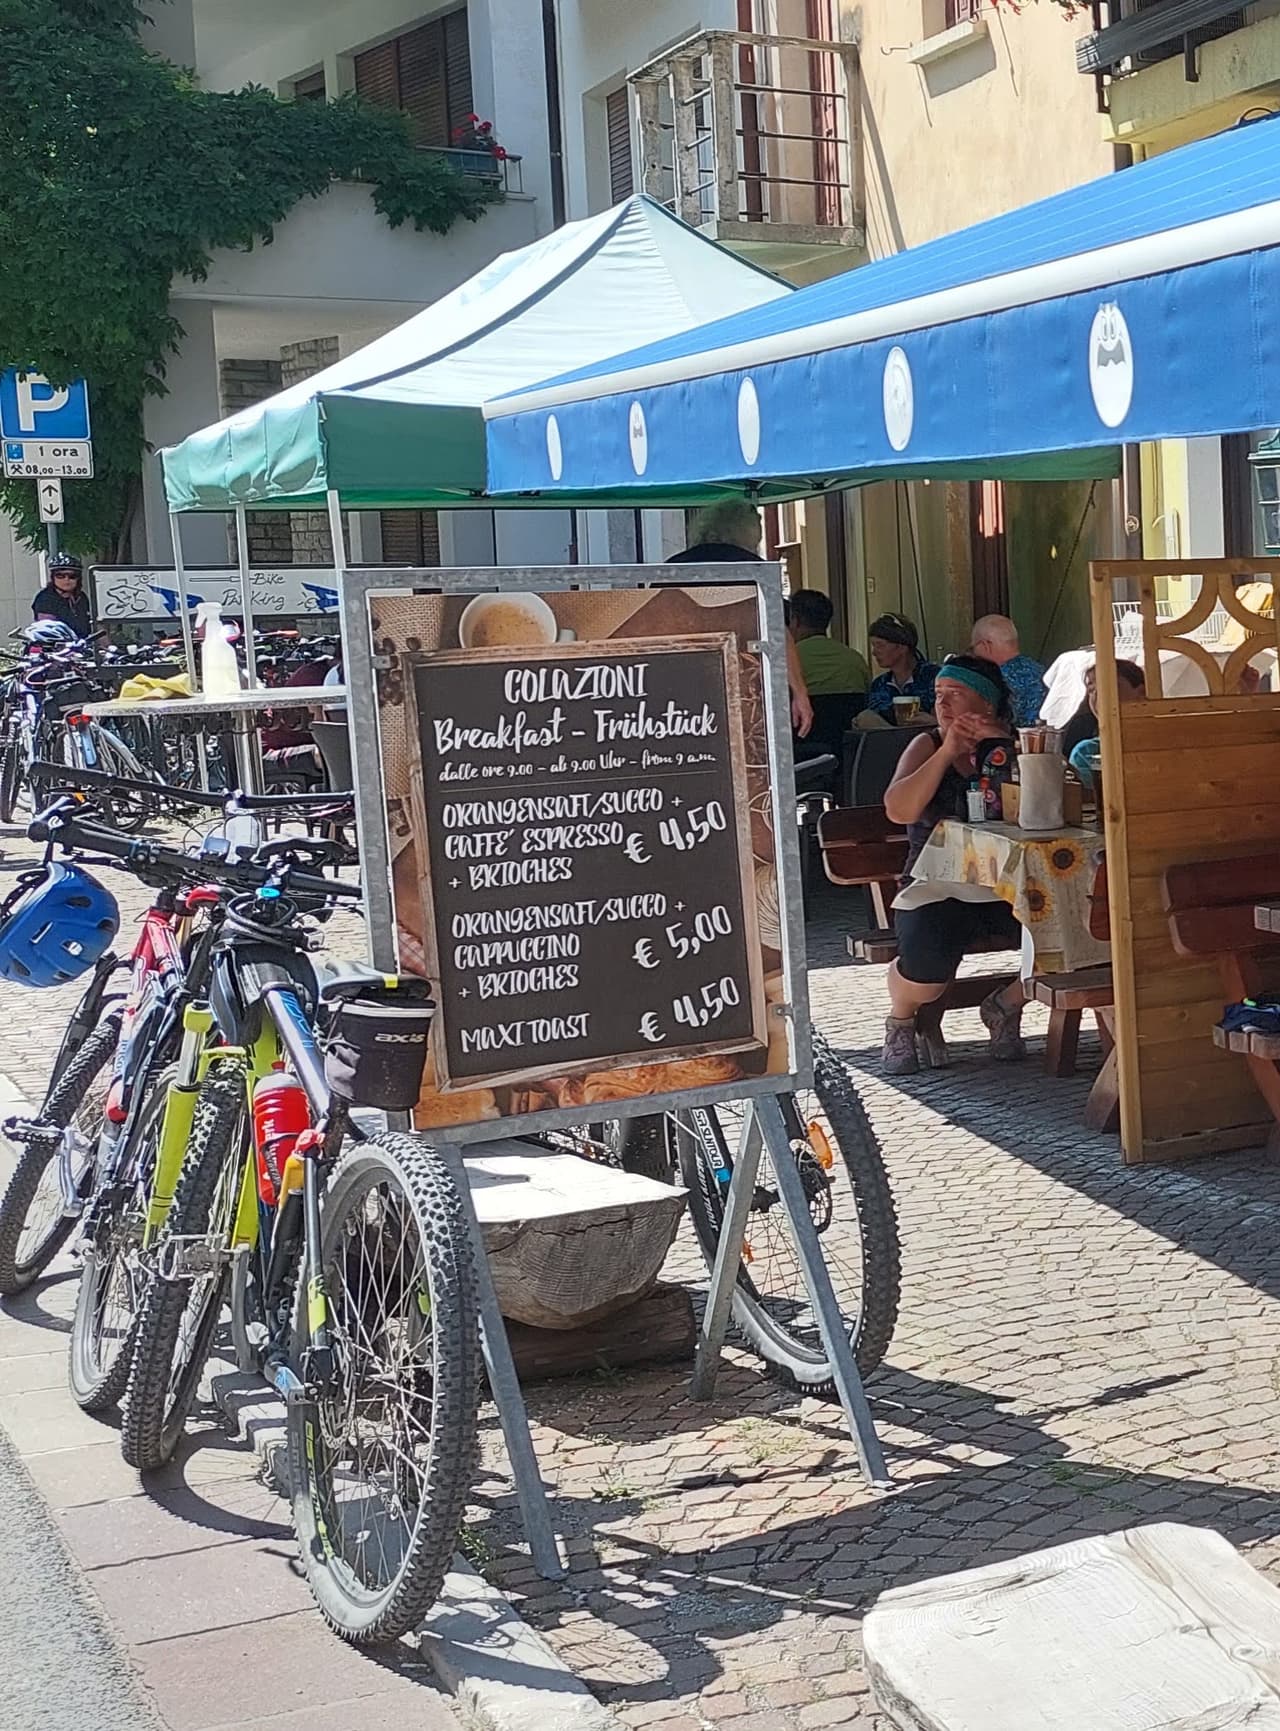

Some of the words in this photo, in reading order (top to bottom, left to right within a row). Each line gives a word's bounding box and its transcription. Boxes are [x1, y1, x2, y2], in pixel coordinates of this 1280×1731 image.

[15, 372, 69, 431] P
[38, 446, 45, 457] 1
[52, 447, 79, 457] ora
[504, 663, 649, 704] COLAZIONI
[433, 707, 566, 755] Breakfast
[594, 701, 718, 742] Frühstück
[439, 762, 479, 783] dalle
[482, 765, 504, 778] ore
[507, 763, 533, 778] 9.00
[550, 755, 568, 773] ab
[570, 760, 597, 776] 9.00
[599, 750, 626, 770] Uhr
[641, 749, 673, 769] from
[675, 753, 684, 766] 9
[686, 752, 717, 764] a.m.
[442, 788, 664, 828] ORANGENSAFT/SUCCO
[671, 796, 683, 807] +
[521, 821, 624, 854] ESPRESSO
[623, 832, 653, 864] €
[659, 800, 727, 851] 4,50
[449, 877, 462, 889] +
[469, 857, 573, 891] BRIOCHES
[451, 893, 667, 939] ORANGENSAFT/SUCCO
[674, 901, 686, 912] +
[454, 933, 581, 970] CAPPUCCINO
[632, 937, 661, 969] €
[665, 905, 733, 960] 5,00
[458, 988, 472, 999] +
[477, 964, 579, 1000] BRIOCHES
[638, 1011, 667, 1042] €
[673, 976, 741, 1028] 4,50
[374, 1033, 426, 1043] axis
[461, 1021, 525, 1053] MAXI
[526, 1012, 591, 1039] TOAST
[701, 1127, 722, 1168] SUNTOUR
